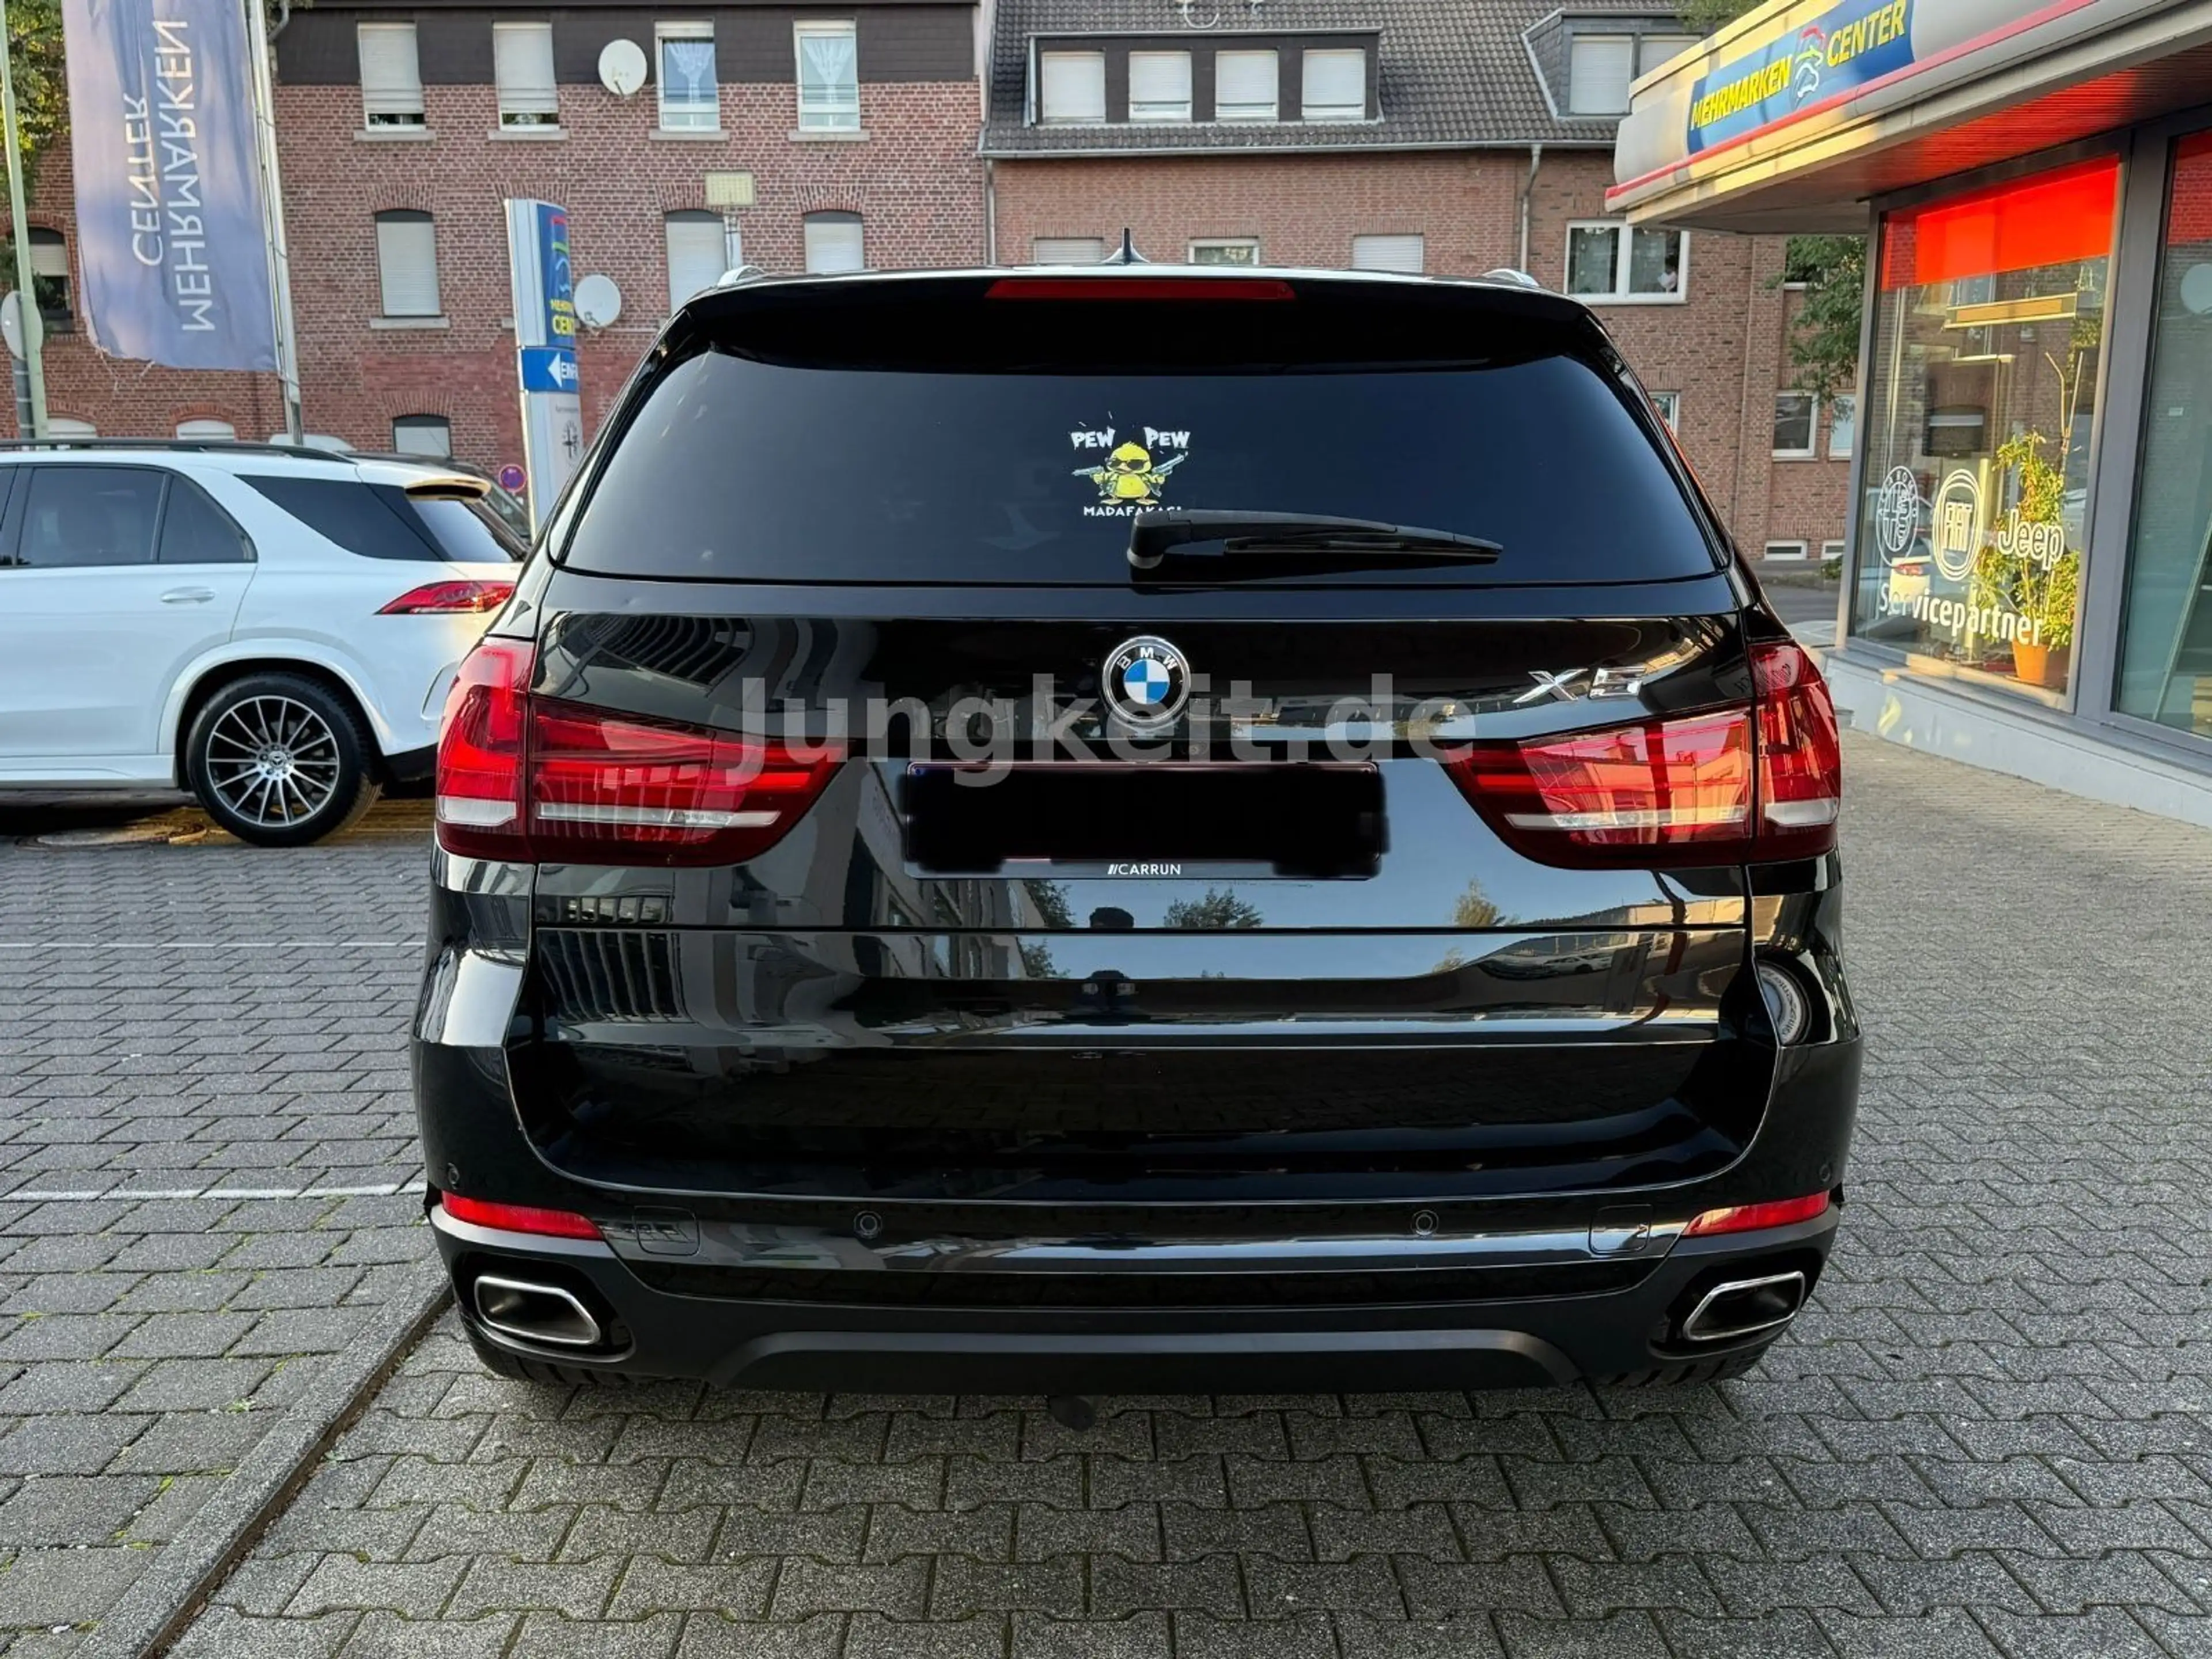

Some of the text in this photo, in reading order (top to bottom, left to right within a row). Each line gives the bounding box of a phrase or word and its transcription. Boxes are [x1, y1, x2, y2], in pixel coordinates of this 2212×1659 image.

[1691, 0, 1907, 131] MEHRMARKEN CENTER
[1070, 426, 1191, 450] PEW PEW
[1998, 509, 2065, 571] Jeep
[1879, 582, 2044, 646] Servicepartner
[1116, 647, 1178, 671] BMW
[1512, 666, 1646, 703] X5
